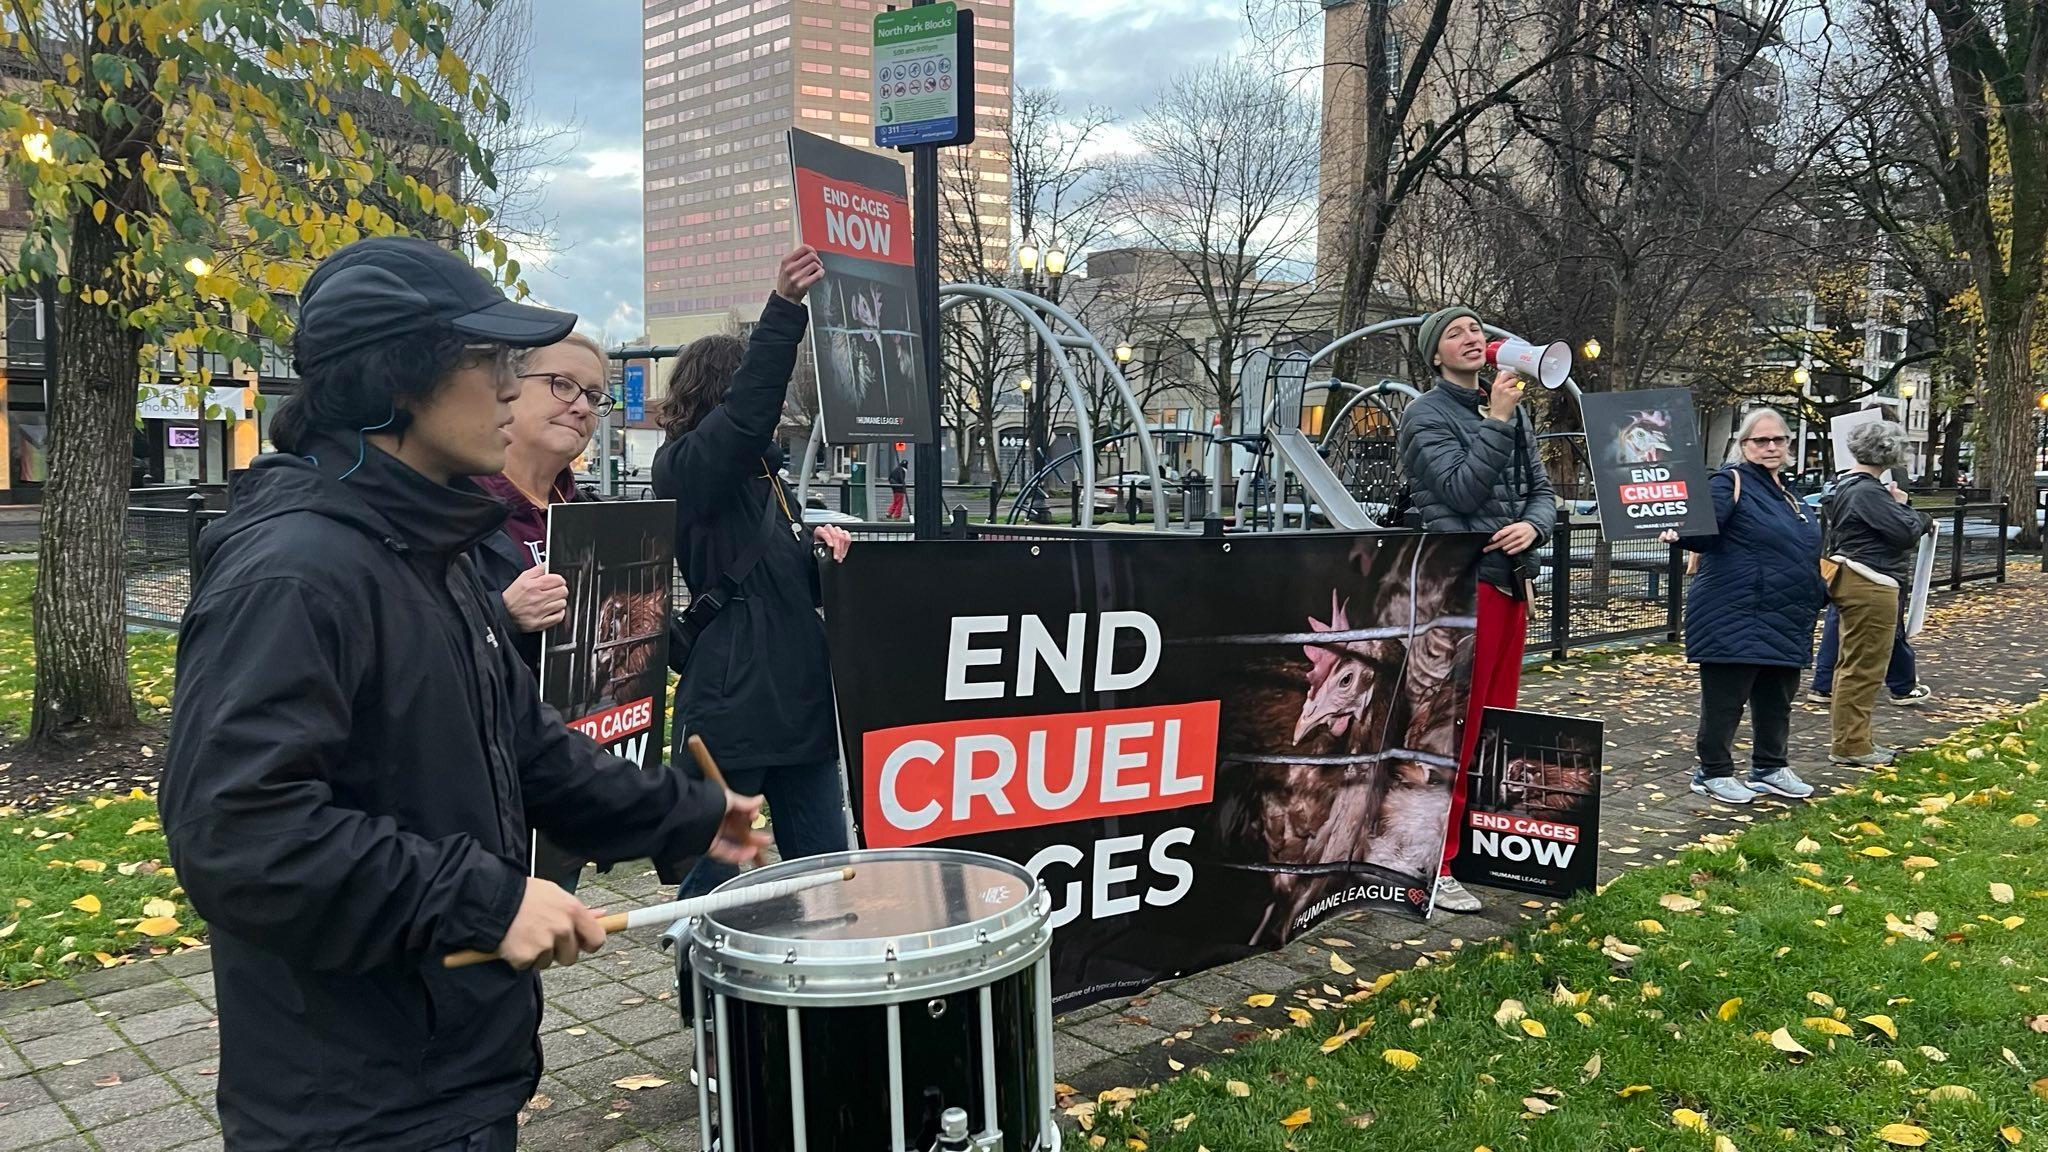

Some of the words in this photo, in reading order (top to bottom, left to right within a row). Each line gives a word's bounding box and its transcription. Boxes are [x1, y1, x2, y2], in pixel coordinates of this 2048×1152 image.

[878, 26, 903, 38] North
[904, 22, 923, 34] Park
[924, 18, 952, 30] Blocks
[887, 126, 900, 135] 311
[823, 186, 849, 208] END
[852, 195, 890, 219] CAGES
[826, 207, 891, 256] NOW
[1631, 467, 1670, 483] END
[1624, 484, 1684, 501] CRUEL
[1626, 501, 1688, 518] CAGES
[945, 611, 1162, 701] END
[601, 702, 650, 738] CAGES
[879, 719, 1203, 830] CRUEL
[1472, 813, 1511, 830] END
[1514, 819, 1577, 840] CAGES
[1472, 829, 1576, 869] NOW
[1024, 827, 1195, 929] GES
[1296, 892, 1342, 928] HUMANE
[1341, 885, 1406, 903] LEAGUE
[1052, 989, 1083, 1003] esentative
